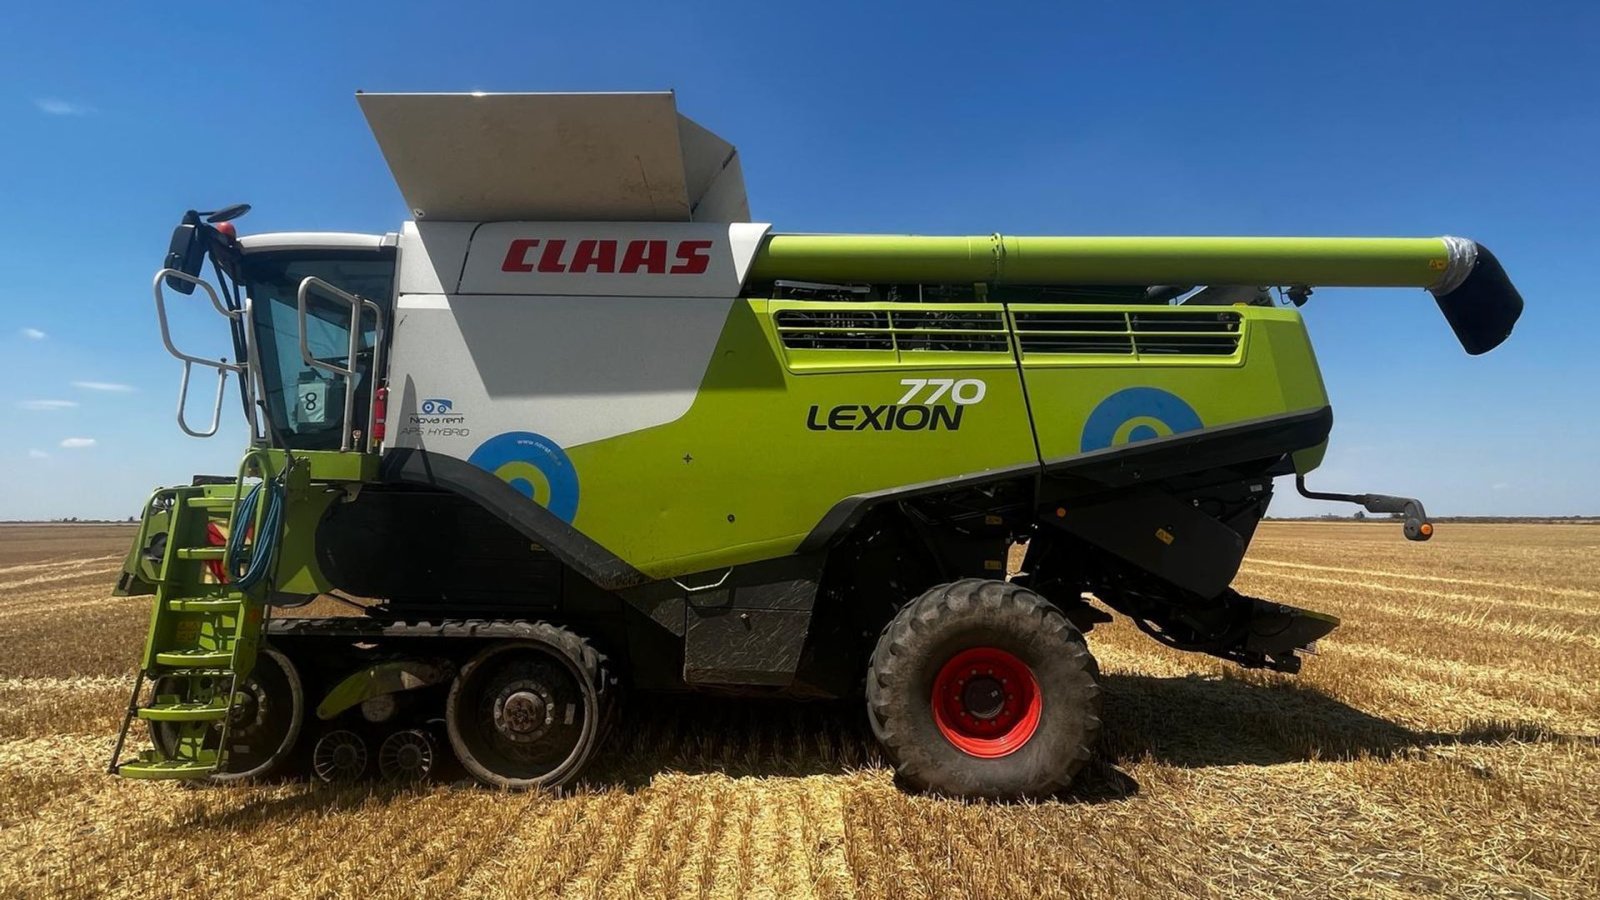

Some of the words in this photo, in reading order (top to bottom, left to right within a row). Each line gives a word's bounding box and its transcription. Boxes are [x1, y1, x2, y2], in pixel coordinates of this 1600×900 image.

[501, 239, 713, 275] CLAAS
[305, 392, 317, 411] 8
[897, 378, 987, 405] 770
[409, 416, 440, 424] Nova
[441, 416, 465, 424] rent
[806, 404, 964, 431] LEXION
[427, 427, 470, 437] HYBRID
